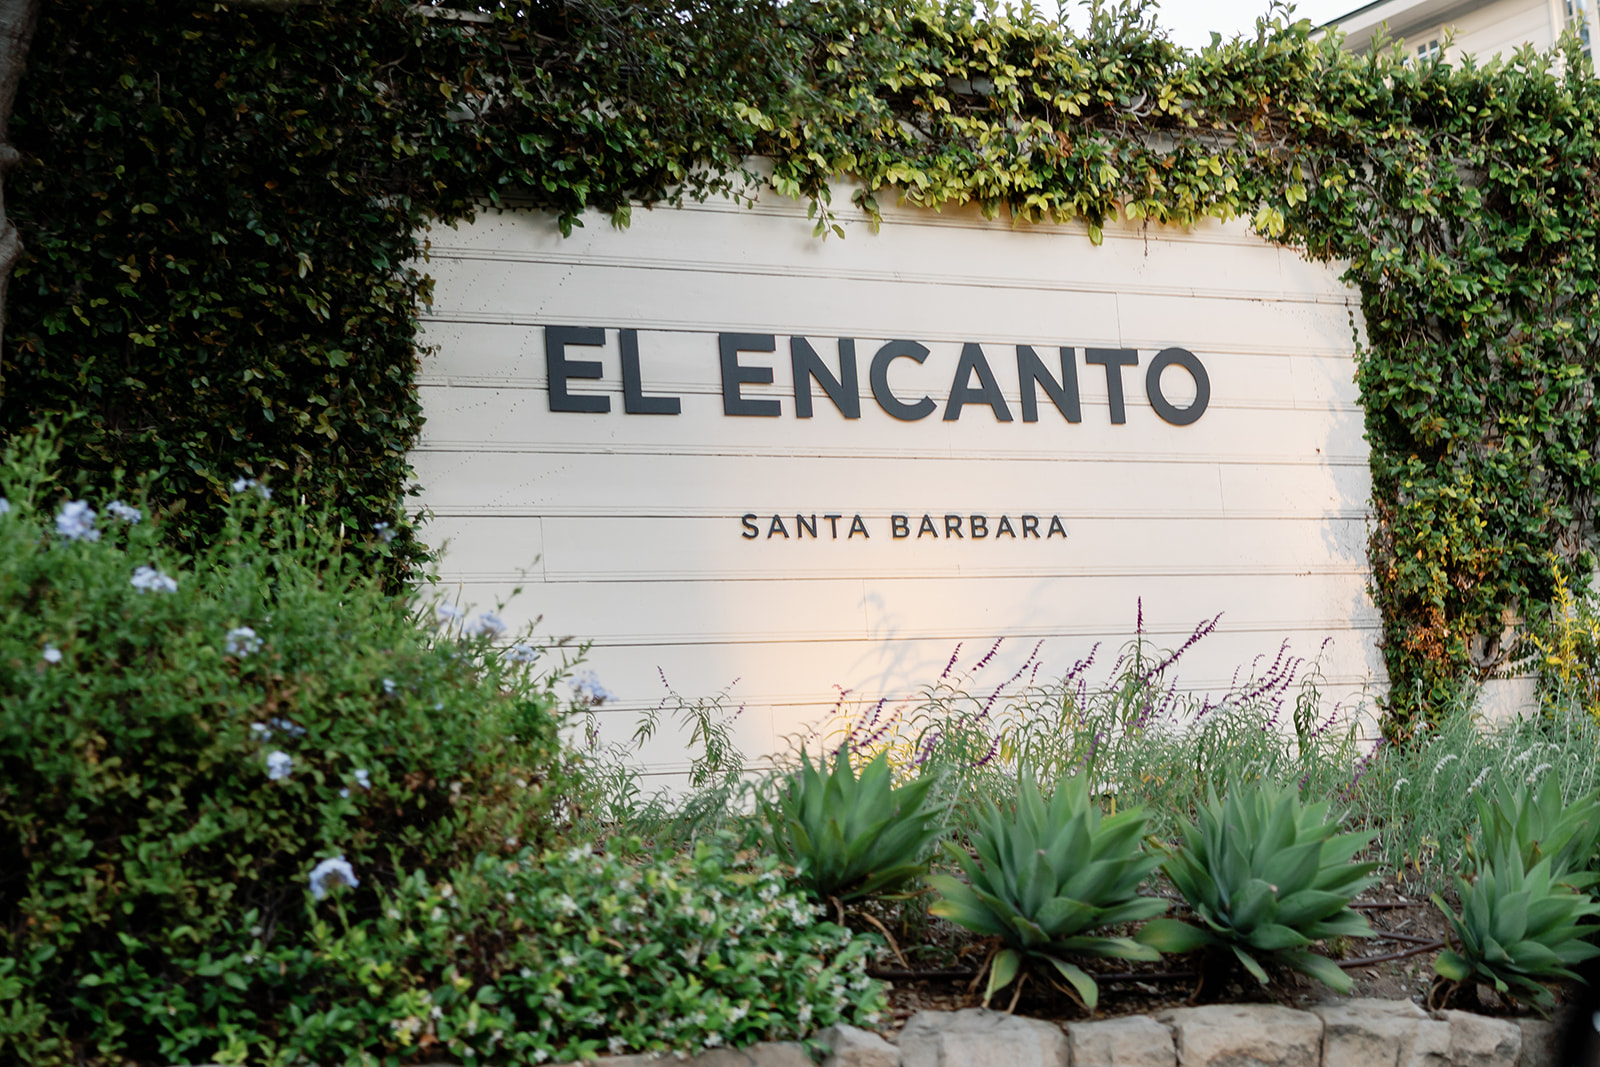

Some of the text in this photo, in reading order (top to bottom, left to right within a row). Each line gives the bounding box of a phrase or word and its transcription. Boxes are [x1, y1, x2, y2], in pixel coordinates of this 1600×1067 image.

[545, 325, 1211, 427] EL ENCANTO
[741, 513, 1069, 540] SANTA BARBARA
